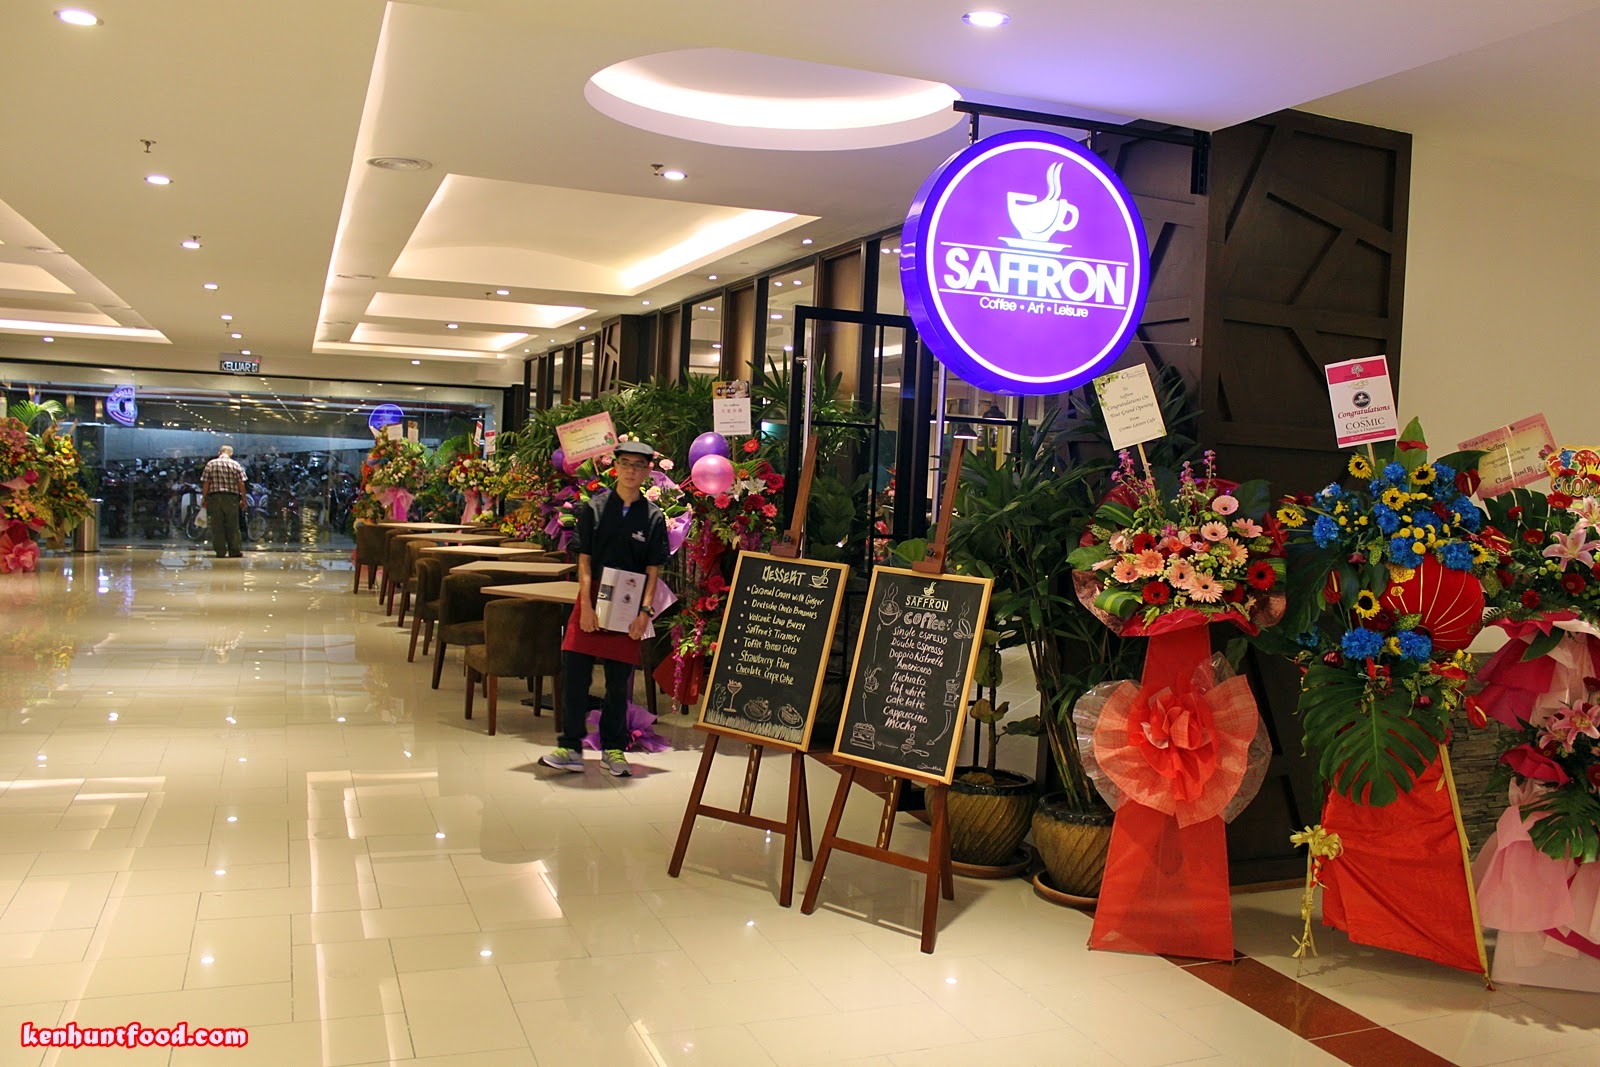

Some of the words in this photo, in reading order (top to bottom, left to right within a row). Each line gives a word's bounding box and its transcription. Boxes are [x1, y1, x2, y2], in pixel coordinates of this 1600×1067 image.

[944, 248, 1126, 305] SAFFRON
[979, 296, 1017, 312] Coffee
[1027, 302, 1045, 315] Art
[1054, 303, 1089, 318] Leisure
[222, 361, 250, 372] KELUAR
[1107, 397, 1142, 412] Congratulations
[1121, 408, 1134, 416] Grand
[1136, 402, 1154, 412] Opening
[1338, 405, 1390, 419] Congratulations
[1346, 416, 1386, 431] COSMIC
[1561, 477, 1600, 497] CON
[750, 584, 775, 597] Caramel
[805, 594, 824, 610] Ginger
[906, 596, 949, 611] SAFFRON
[772, 614, 785, 626] Lava
[786, 619, 806, 630] Burst
[891, 637, 914, 648] Double
[919, 631, 948, 645] espresso
[782, 644, 797, 655] Cotta
[889, 648, 914, 662] Doppio
[738, 650, 774, 668] Strawberry
[776, 657, 790, 670] Flan
[896, 660, 932, 675] Americano
[736, 663, 762, 676] Chocolate
[780, 673, 794, 685] Cake
[905, 686, 926, 698] white
[885, 717, 917, 732] Mocha
